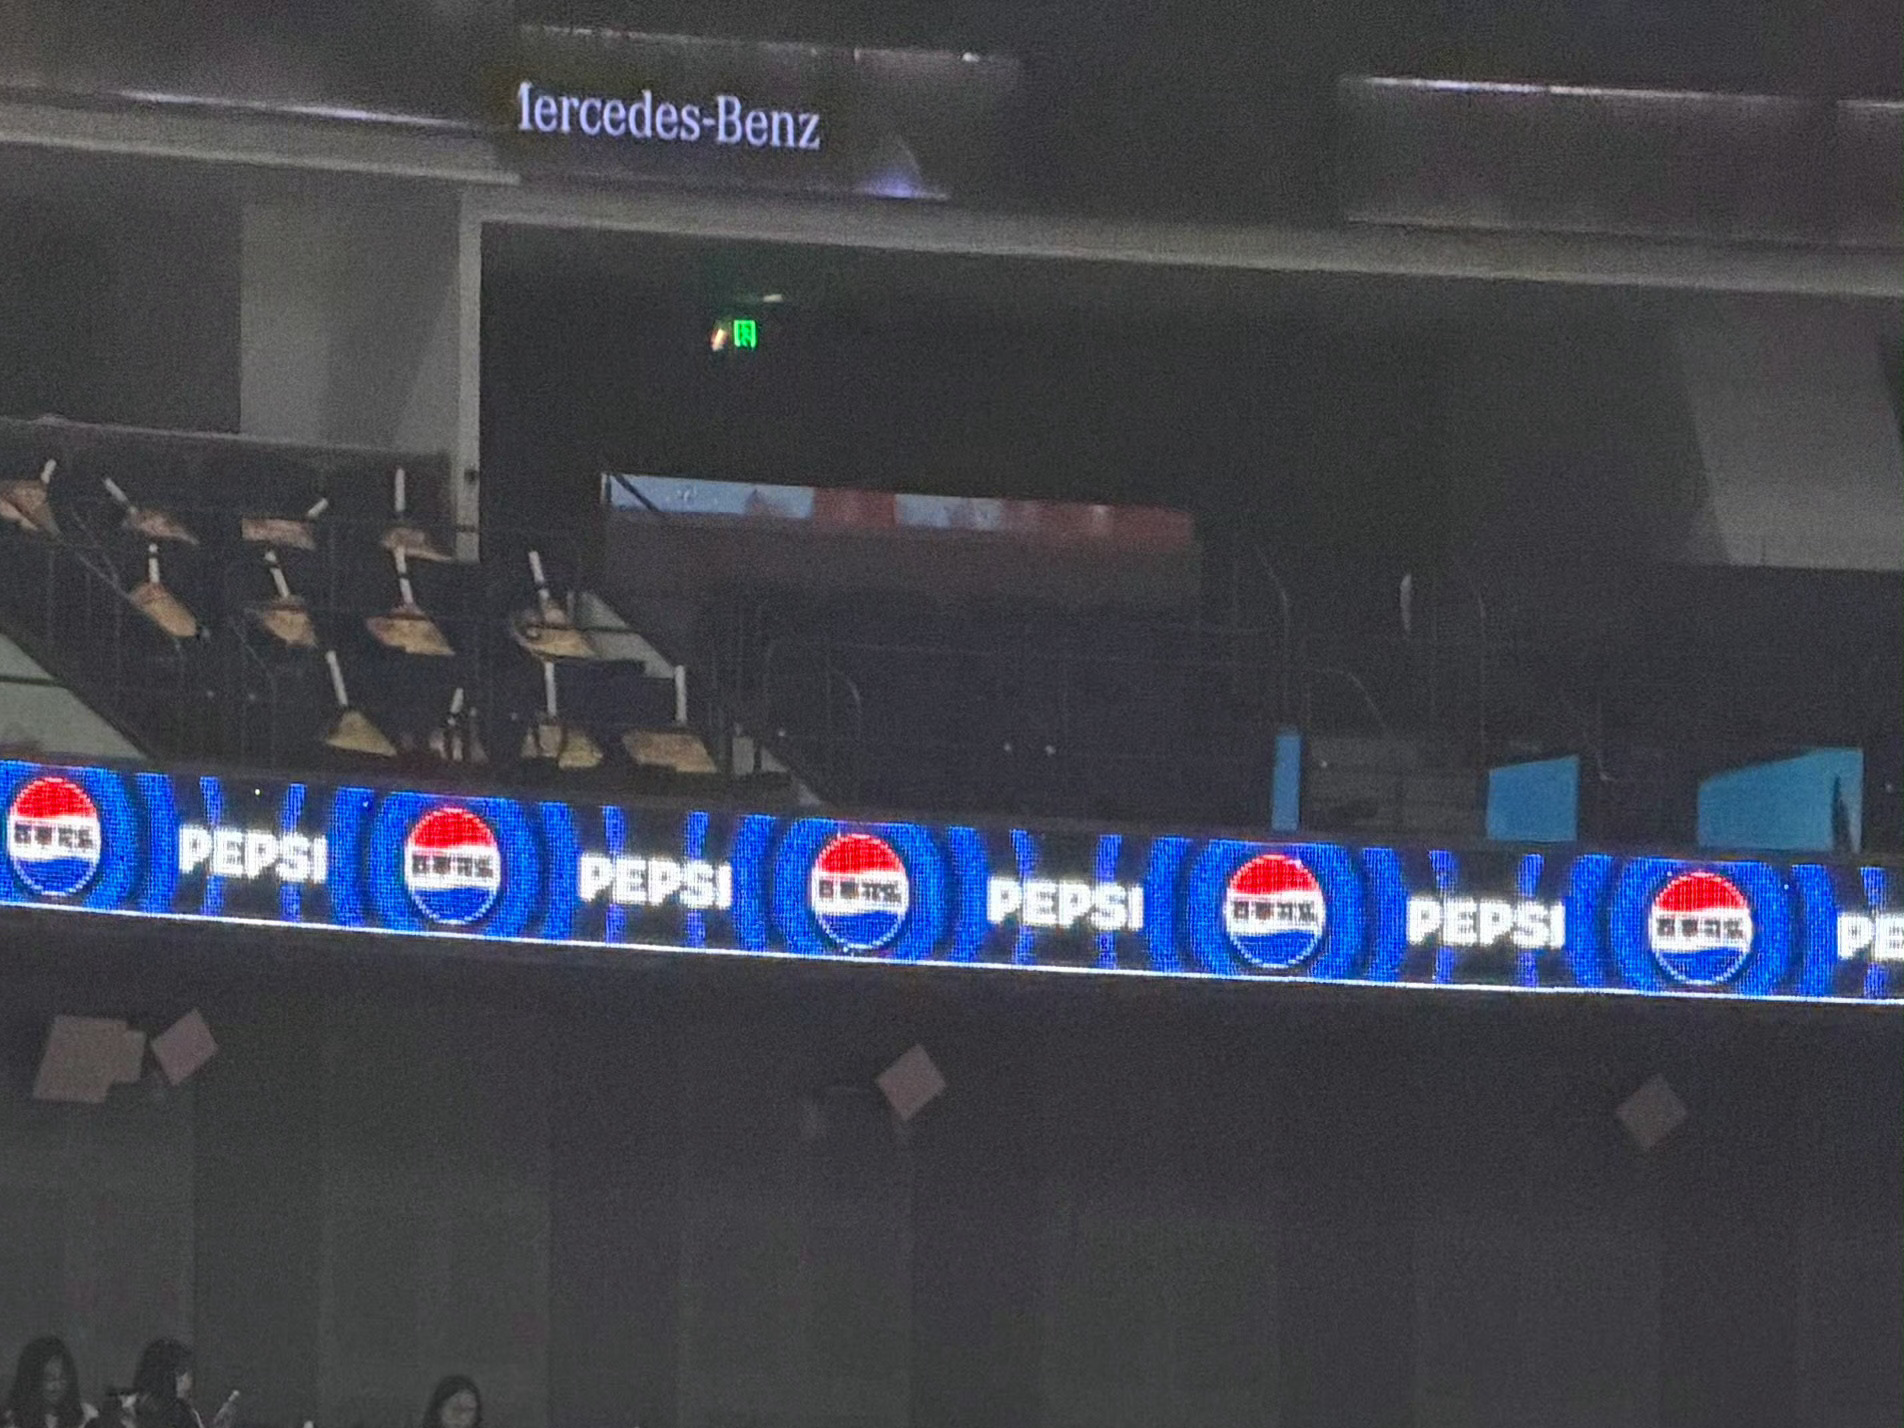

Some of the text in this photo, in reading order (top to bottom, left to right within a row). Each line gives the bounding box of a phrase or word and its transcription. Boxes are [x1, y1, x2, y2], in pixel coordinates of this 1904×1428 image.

[180, 825, 327, 883] PEPSI
[579, 853, 732, 909] PEPSI
[988, 876, 1143, 931] PEPSI
[1407, 896, 1564, 949] PEPSI
